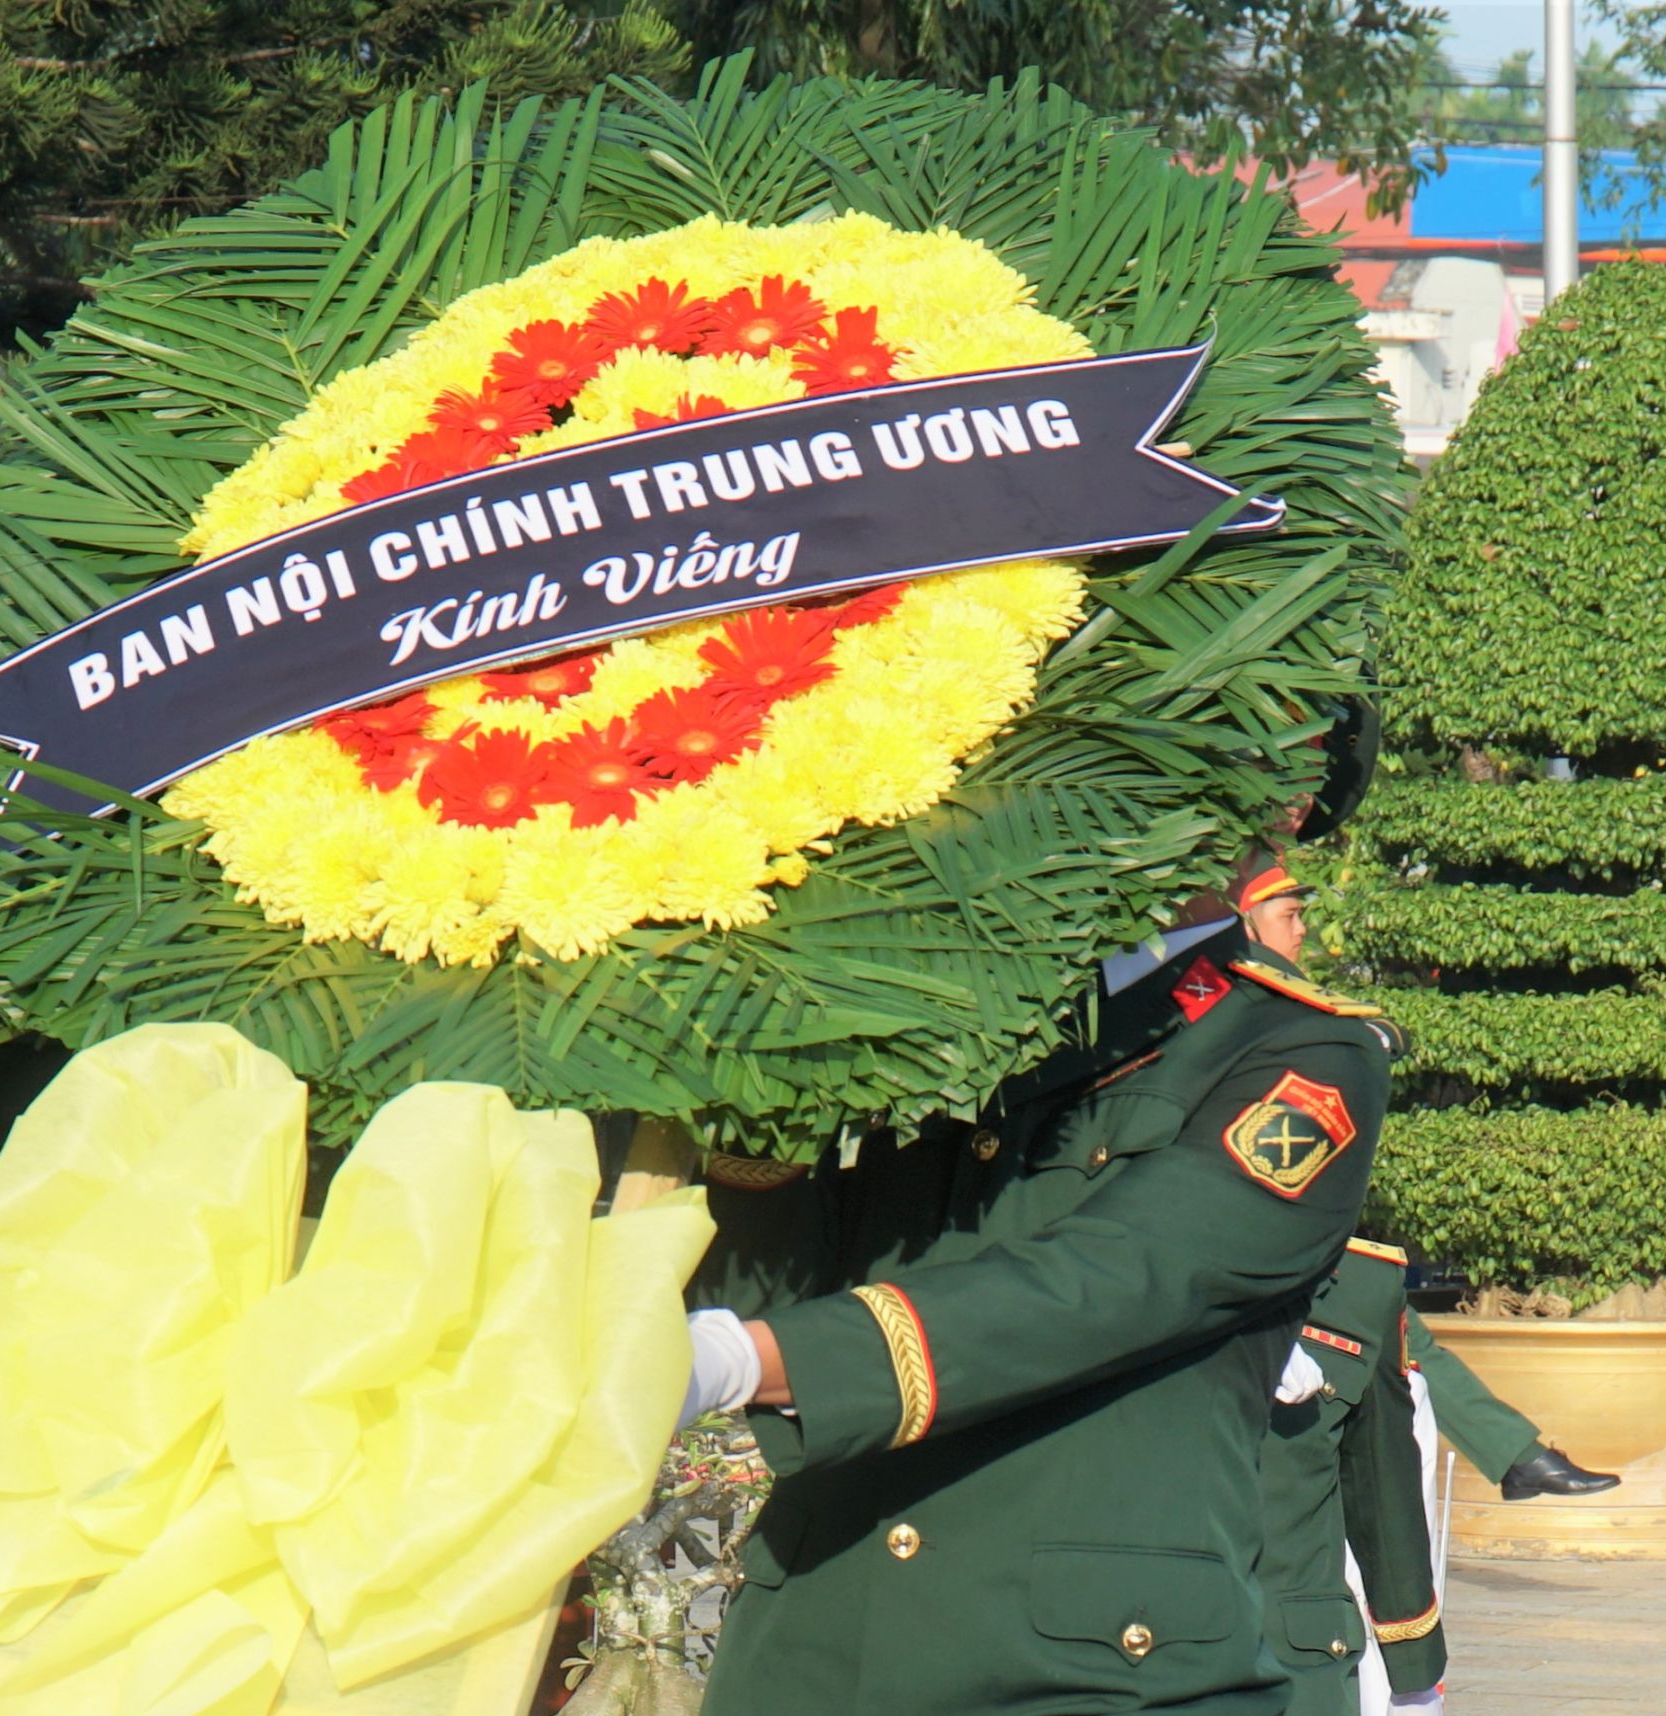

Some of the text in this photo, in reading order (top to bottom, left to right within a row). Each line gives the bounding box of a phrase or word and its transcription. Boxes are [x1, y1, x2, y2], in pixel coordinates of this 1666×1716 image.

[68, 400, 1081, 710] BAN NỘI CHÍNH TRUNG ƯƠNG
[380, 531, 801, 667] Kính Viếng
